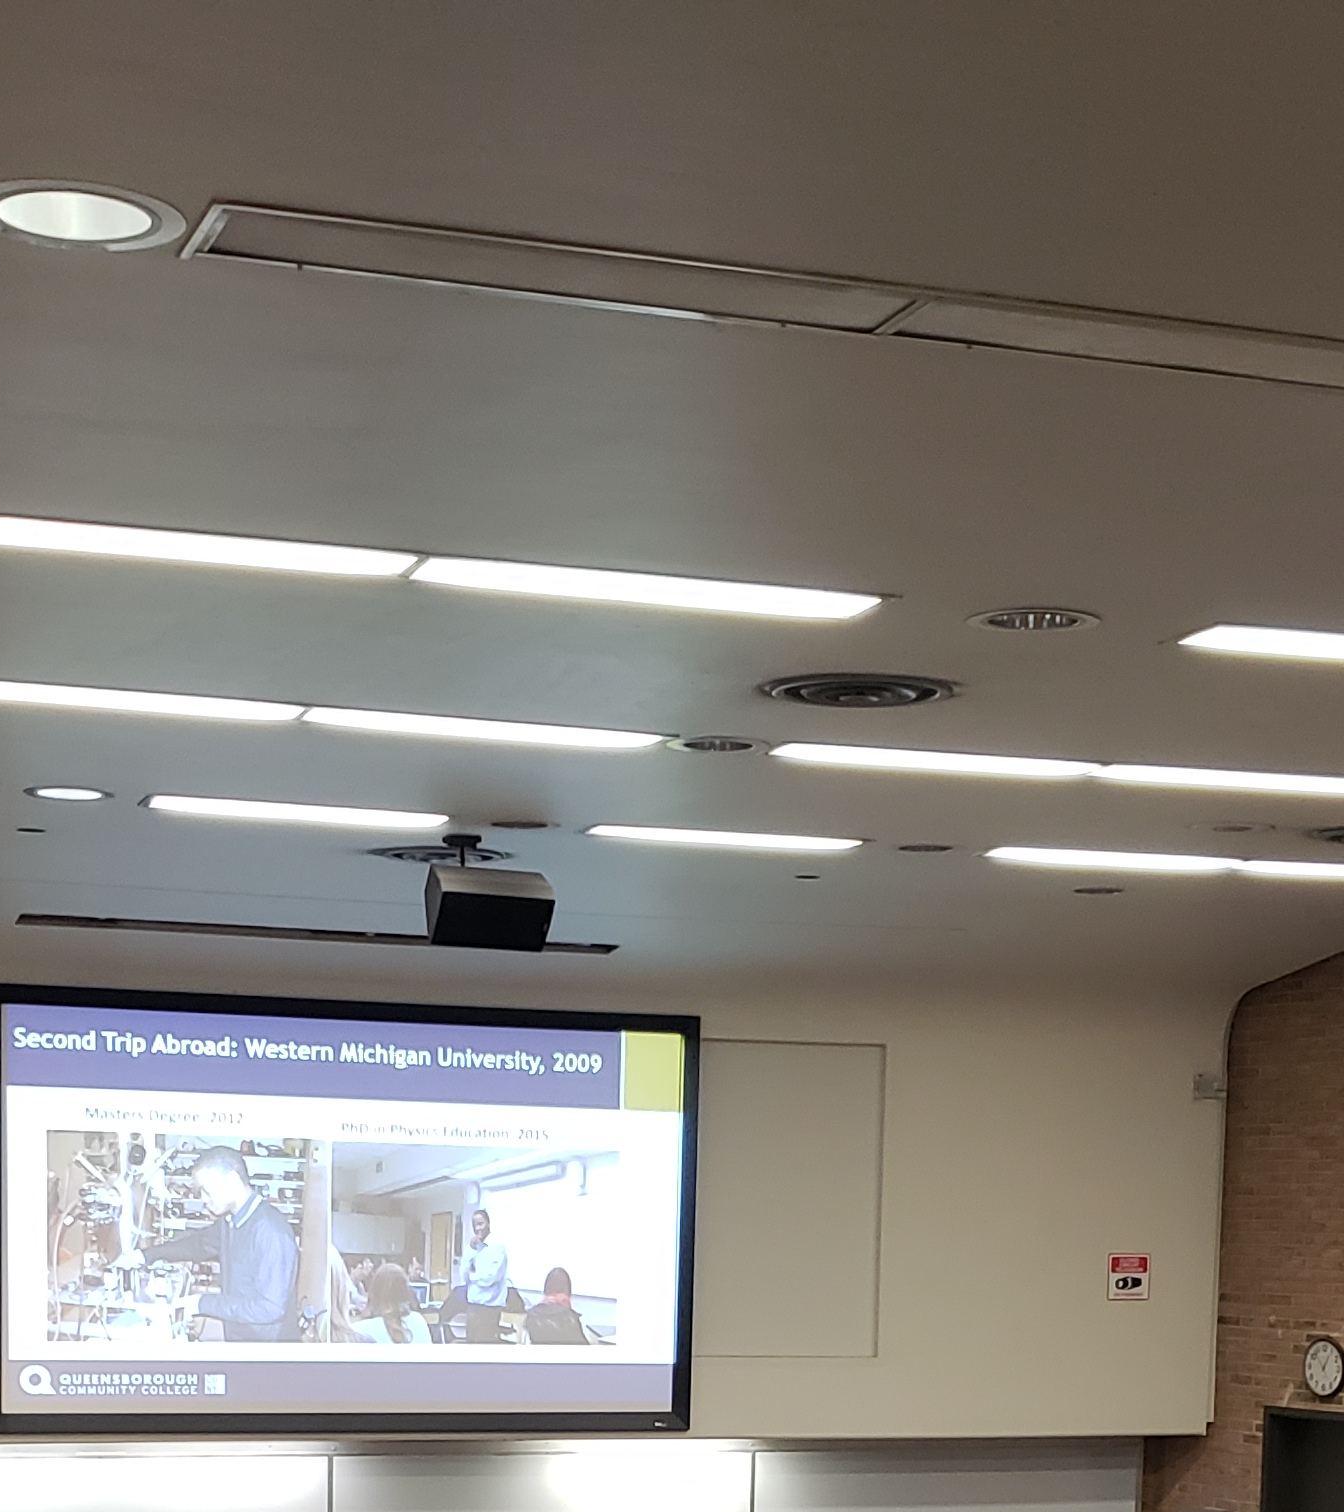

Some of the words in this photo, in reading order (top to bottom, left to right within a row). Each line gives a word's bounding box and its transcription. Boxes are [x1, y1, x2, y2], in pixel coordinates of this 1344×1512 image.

[12, 1026, 97, 1052] Second
[100, 1031, 147, 1058] Trip
[150, 1034, 239, 1058] Abroad:
[244, 1038, 334, 1063] Western
[339, 1042, 432, 1069] Michigan
[437, 1047, 546, 1075] University,
[552, 1052, 603, 1074] 2009
[341, 1122, 369, 1134] PhD
[59, 1373, 198, 1386] QUEENSBOROUGH
[59, 1385, 136, 1395] COMMUNITY
[141, 1385, 198, 1395] COLLEGE
